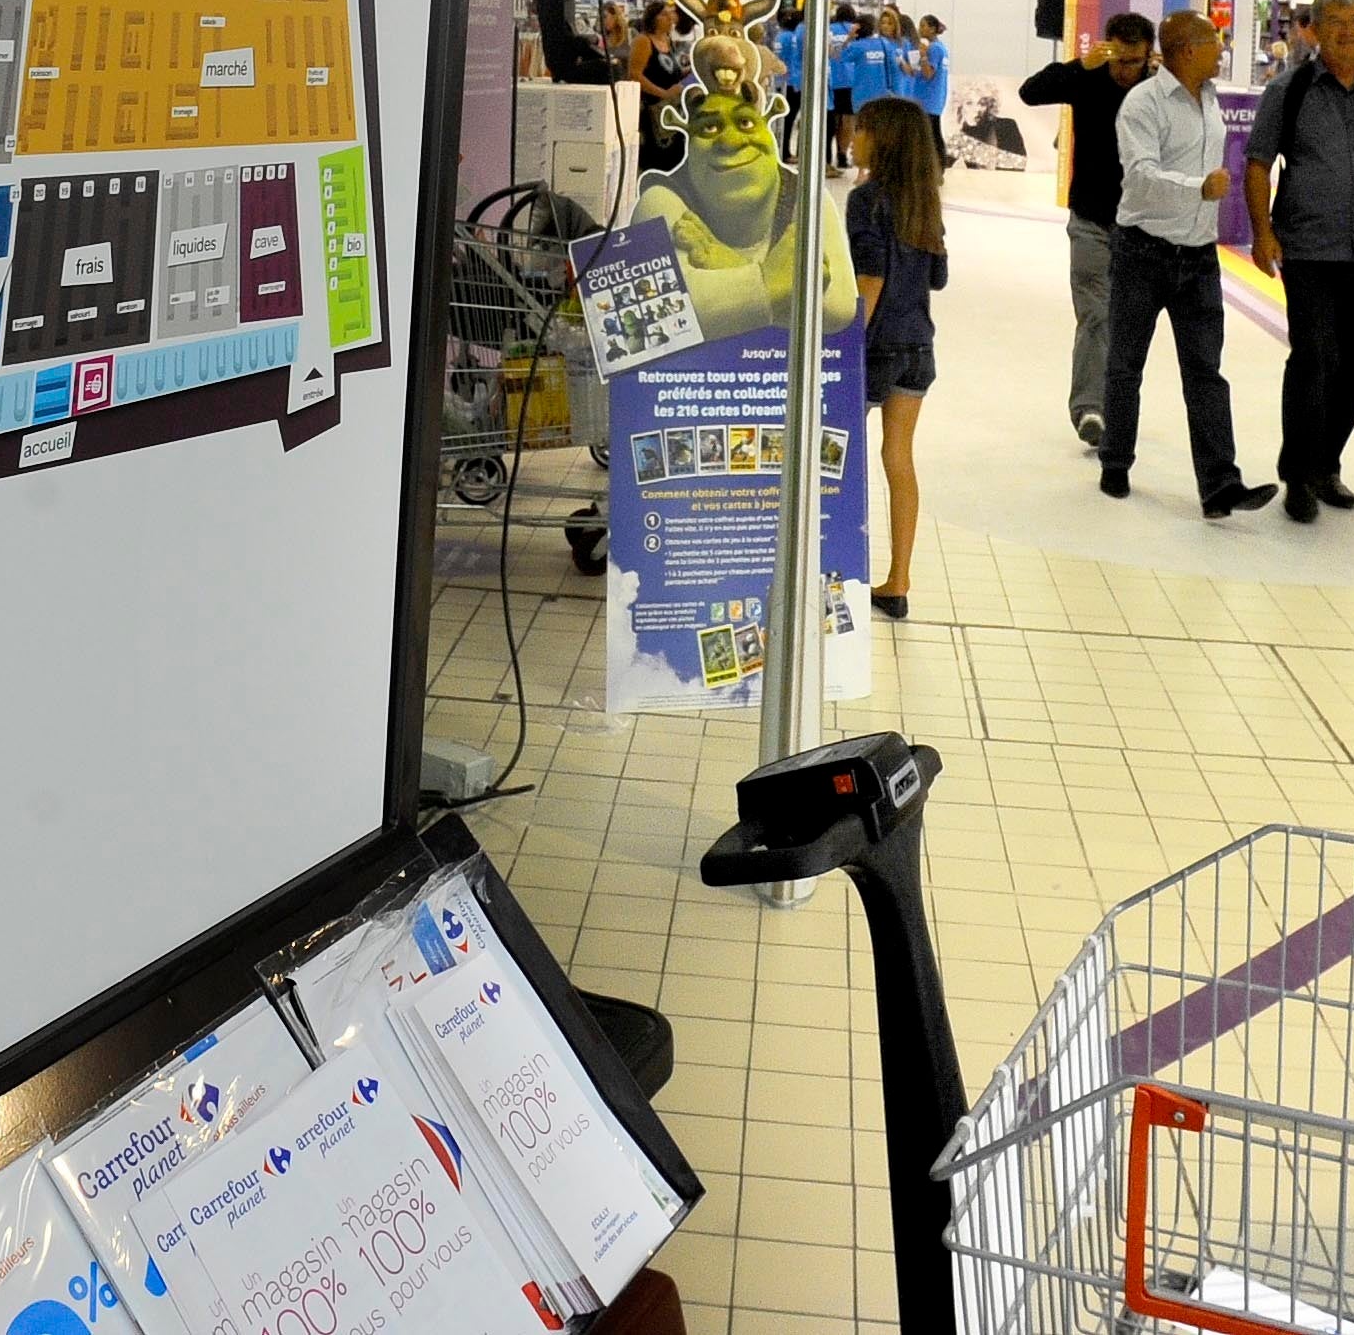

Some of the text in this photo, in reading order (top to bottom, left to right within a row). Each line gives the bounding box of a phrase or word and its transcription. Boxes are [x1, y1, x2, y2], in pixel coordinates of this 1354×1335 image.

[205, 55, 248, 77] marché
[172, 235, 217, 259] liquides
[254, 235, 279, 250] cave
[346, 232, 362, 252] bio
[75, 256, 104, 276] frais
[586, 259, 626, 279] COFFRET
[589, 255, 672, 291] COLLECTION
[638, 370, 705, 383] Retrouvez
[707, 371, 736, 383] tous
[739, 371, 761, 383] vos
[658, 386, 788, 402] préférés en collectio
[676, 404, 699, 417] 216
[701, 405, 740, 417] cartes
[23, 431, 72, 458] accueil
[642, 489, 690, 500] Comment
[757, 485, 780, 497] coffr
[435, 999, 479, 1039] Carrefour
[459, 1013, 486, 1045] planet
[483, 1053, 550, 1120] magasin
[295, 1099, 350, 1152] arrefour
[318, 1116, 357, 1159] planet
[500, 1081, 557, 1158] 100%
[77, 1115, 176, 1200] Carrefour
[527, 1113, 591, 1185] pour vous
[132, 1140, 188, 1202] planet
[189, 1169, 260, 1226] Carrefour
[227, 1185, 268, 1230] planet
[341, 1158, 431, 1239] magasin
[358, 1189, 436, 1287] 100%
[241, 1234, 343, 1326] magasin
[389, 1225, 473, 1316] pour vous
[261, 1268, 348, 1335] 00%
